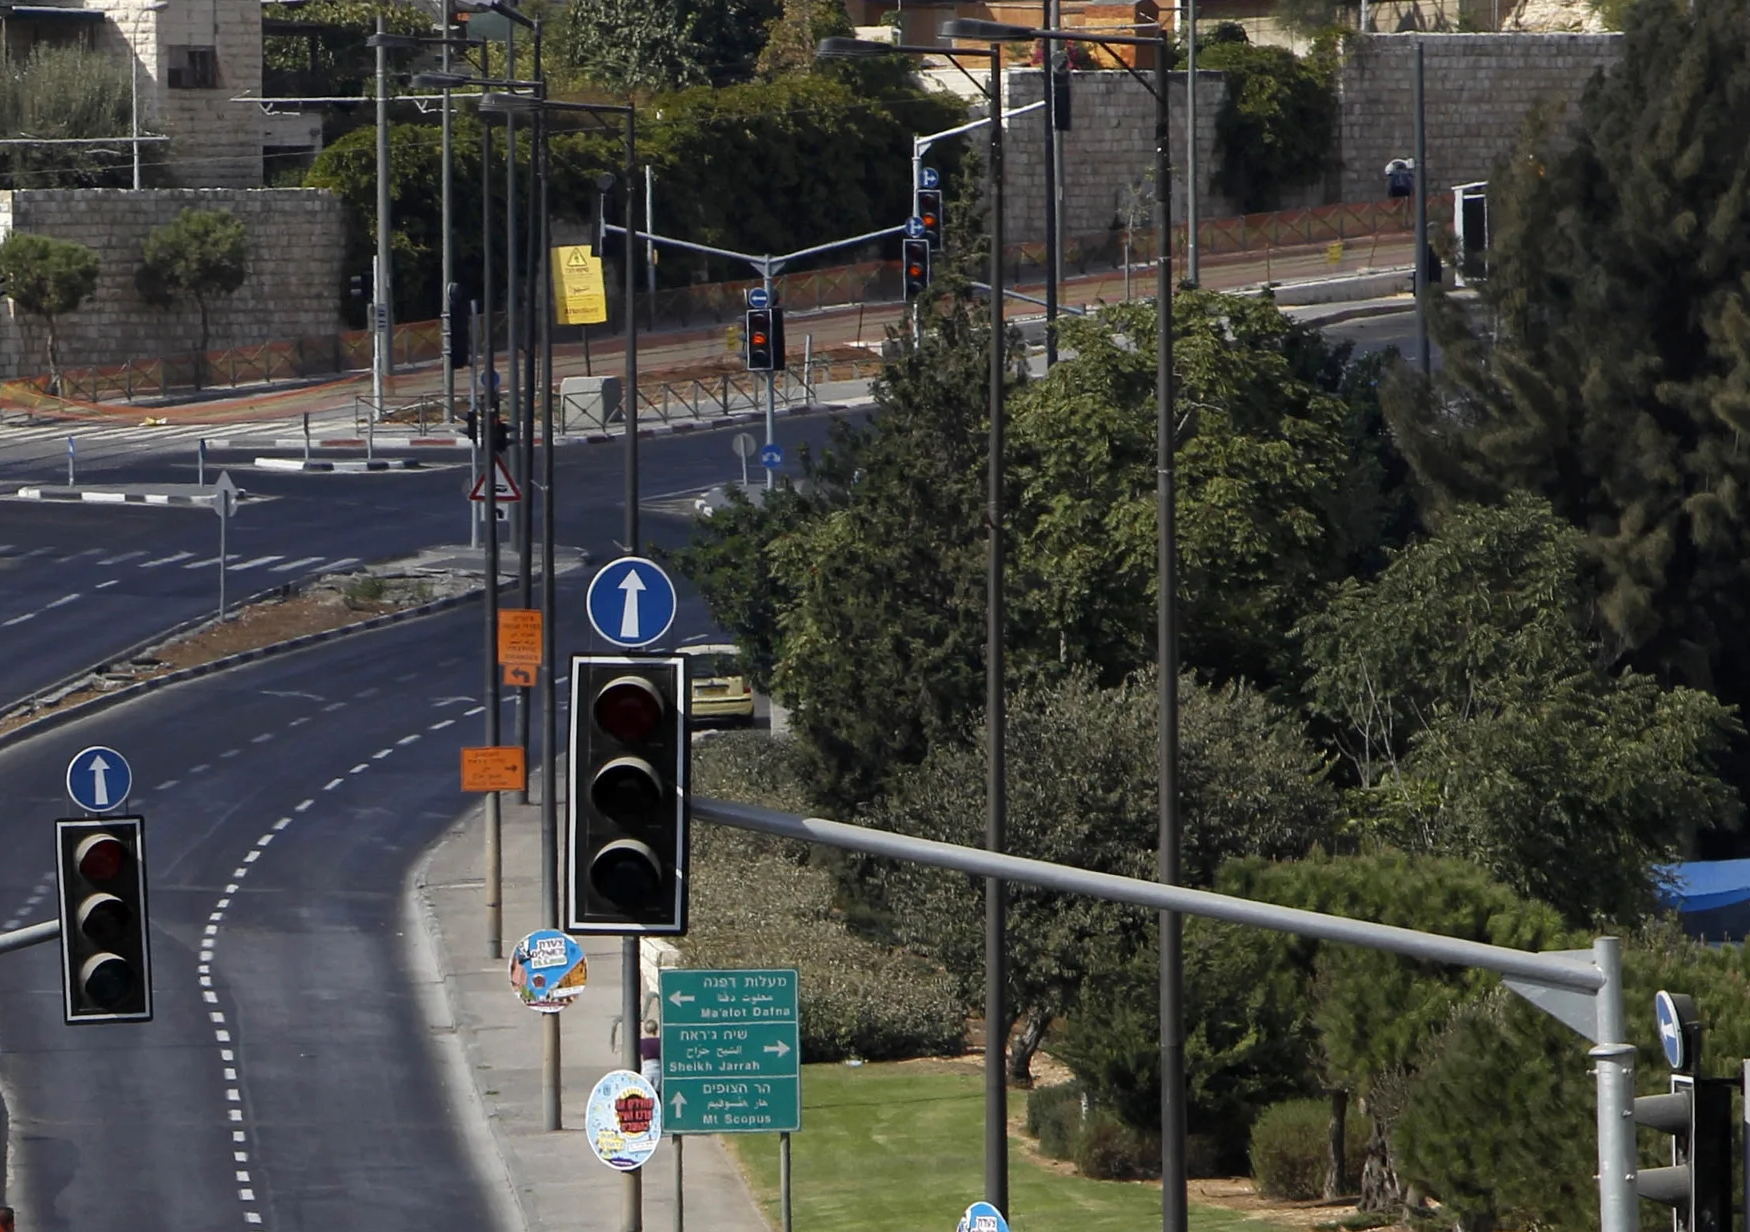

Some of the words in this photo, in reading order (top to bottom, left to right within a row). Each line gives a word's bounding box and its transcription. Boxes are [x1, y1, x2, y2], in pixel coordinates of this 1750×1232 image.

[703, 977, 737, 988] דפנה
[744, 976, 787, 988] מעלות
[700, 1008, 748, 1018] Ma'elot
[752, 1007, 790, 1017] Dafna
[724, 1030, 748, 1040] שיח
[670, 1062, 713, 1072] Sheikh
[718, 1061, 760, 1072] Jarrah
[702, 1084, 748, 1094] הצופים
[754, 1084, 770, 1094] הר
[702, 1114, 718, 1124] Mt
[725, 1114, 771, 1126] Scopus
